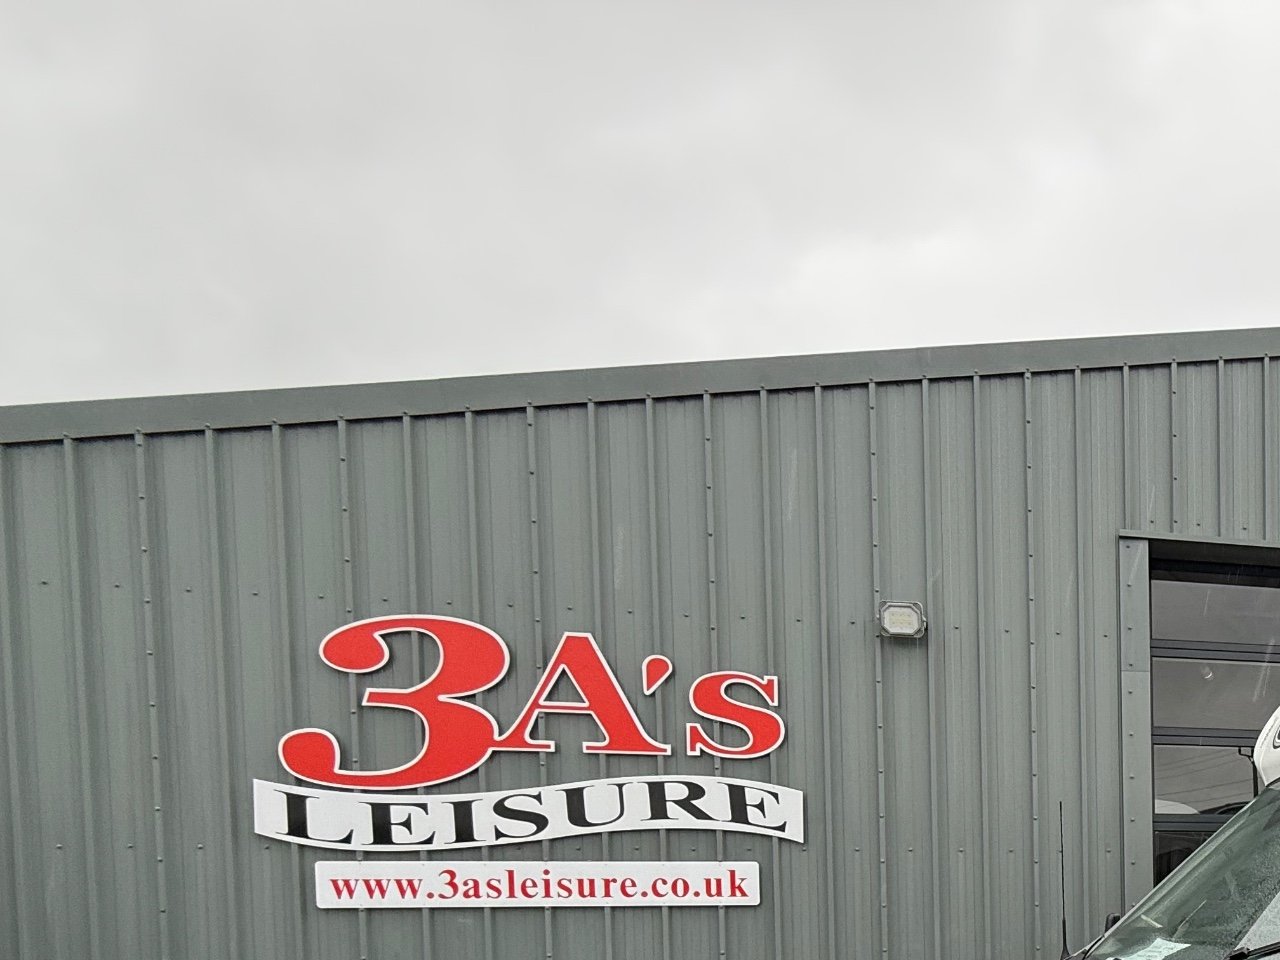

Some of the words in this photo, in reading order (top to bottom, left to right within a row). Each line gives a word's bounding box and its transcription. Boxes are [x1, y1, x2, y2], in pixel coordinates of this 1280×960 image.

[278, 614, 786, 790] 3A's
[274, 781, 788, 846] LEISURE
[330, 869, 749, 900] www.3asleisure.co.uk
